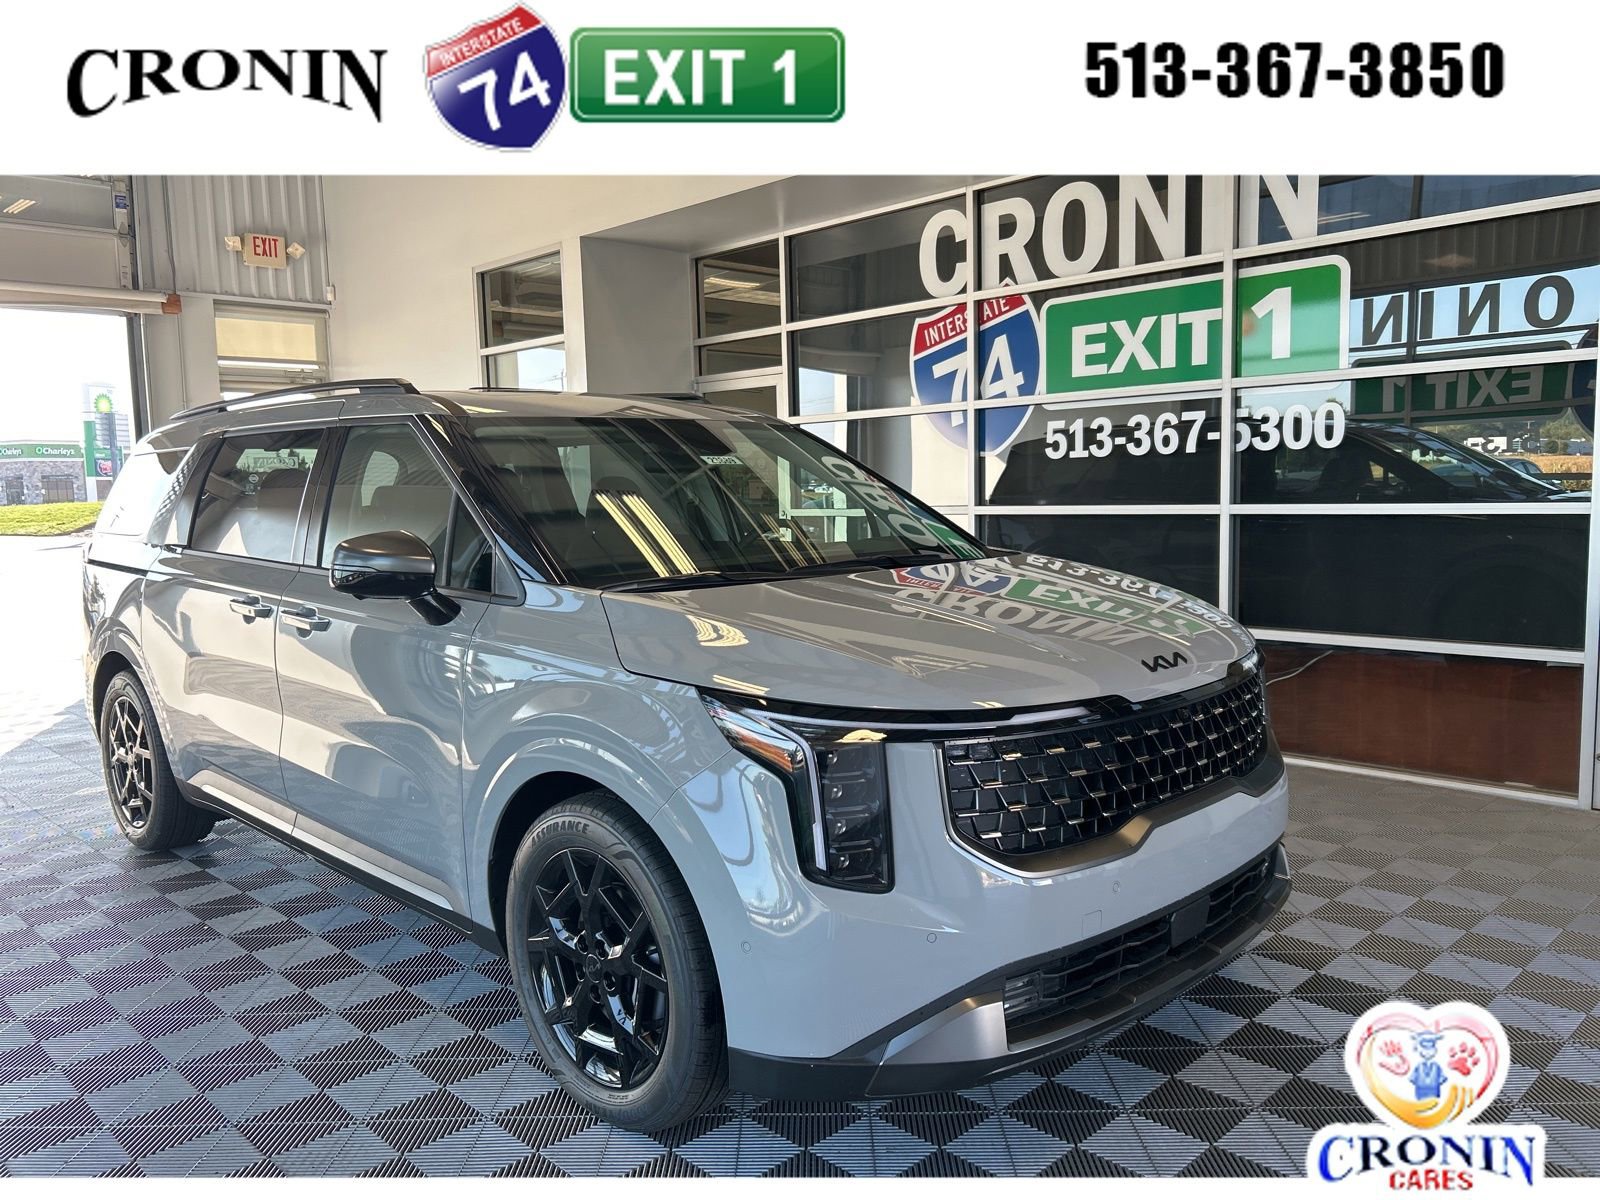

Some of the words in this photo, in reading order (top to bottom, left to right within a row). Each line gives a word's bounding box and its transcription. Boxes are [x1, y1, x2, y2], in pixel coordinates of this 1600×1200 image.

[252, 236, 279, 258] EXIT
[919, 174, 1319, 299] CRONIN
[1071, 307, 1222, 378] EXIT
[1249, 286, 1292, 360] 1
[931, 334, 1025, 428] 74
[1044, 402, 1344, 460] 513-367-5300
